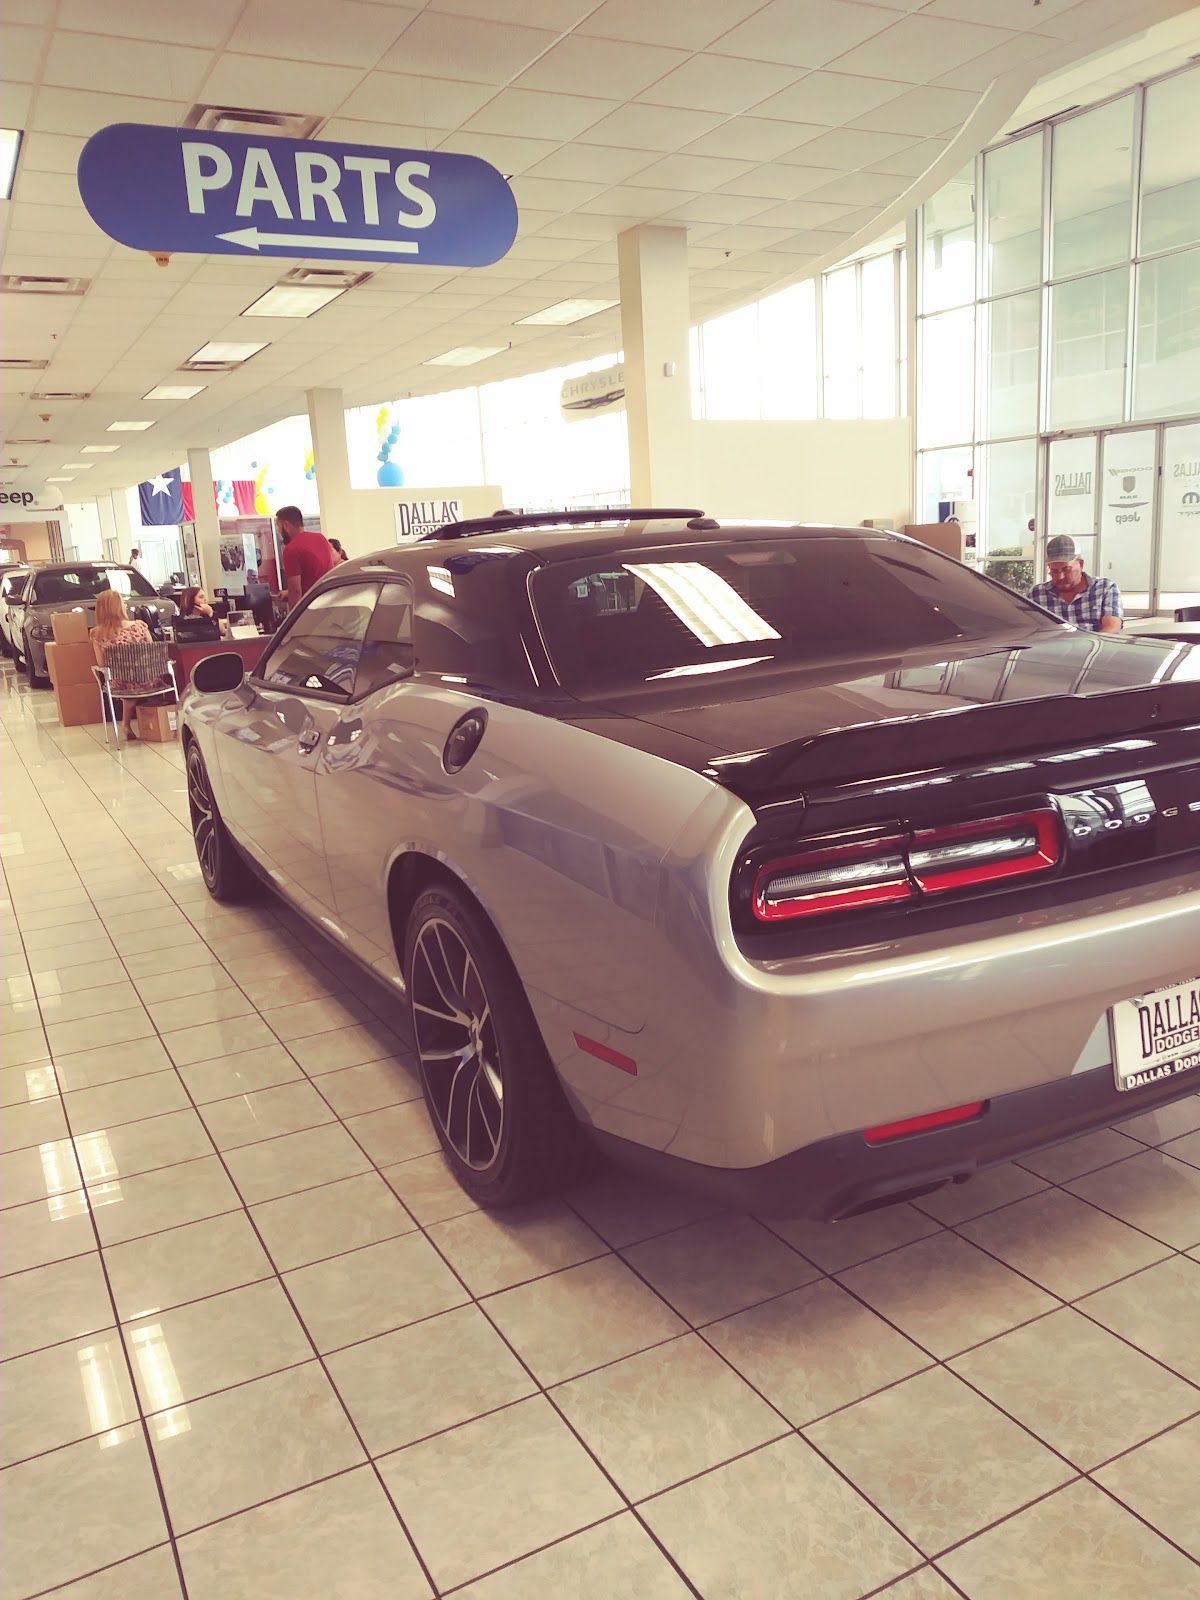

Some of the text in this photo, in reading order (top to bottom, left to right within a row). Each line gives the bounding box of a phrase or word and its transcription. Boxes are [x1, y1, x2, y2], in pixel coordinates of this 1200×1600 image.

[181, 142, 437, 229] PARTS
[561, 371, 624, 399] CHRYSLE
[0, 491, 34, 506] eep
[398, 501, 458, 536] DALLAS
[1073, 802, 1200, 837] DODGE
[1138, 990, 1200, 1058] DALLA
[1156, 1027, 1199, 1053] DODGE
[1127, 1053, 1200, 1089] DALLAS DOD
